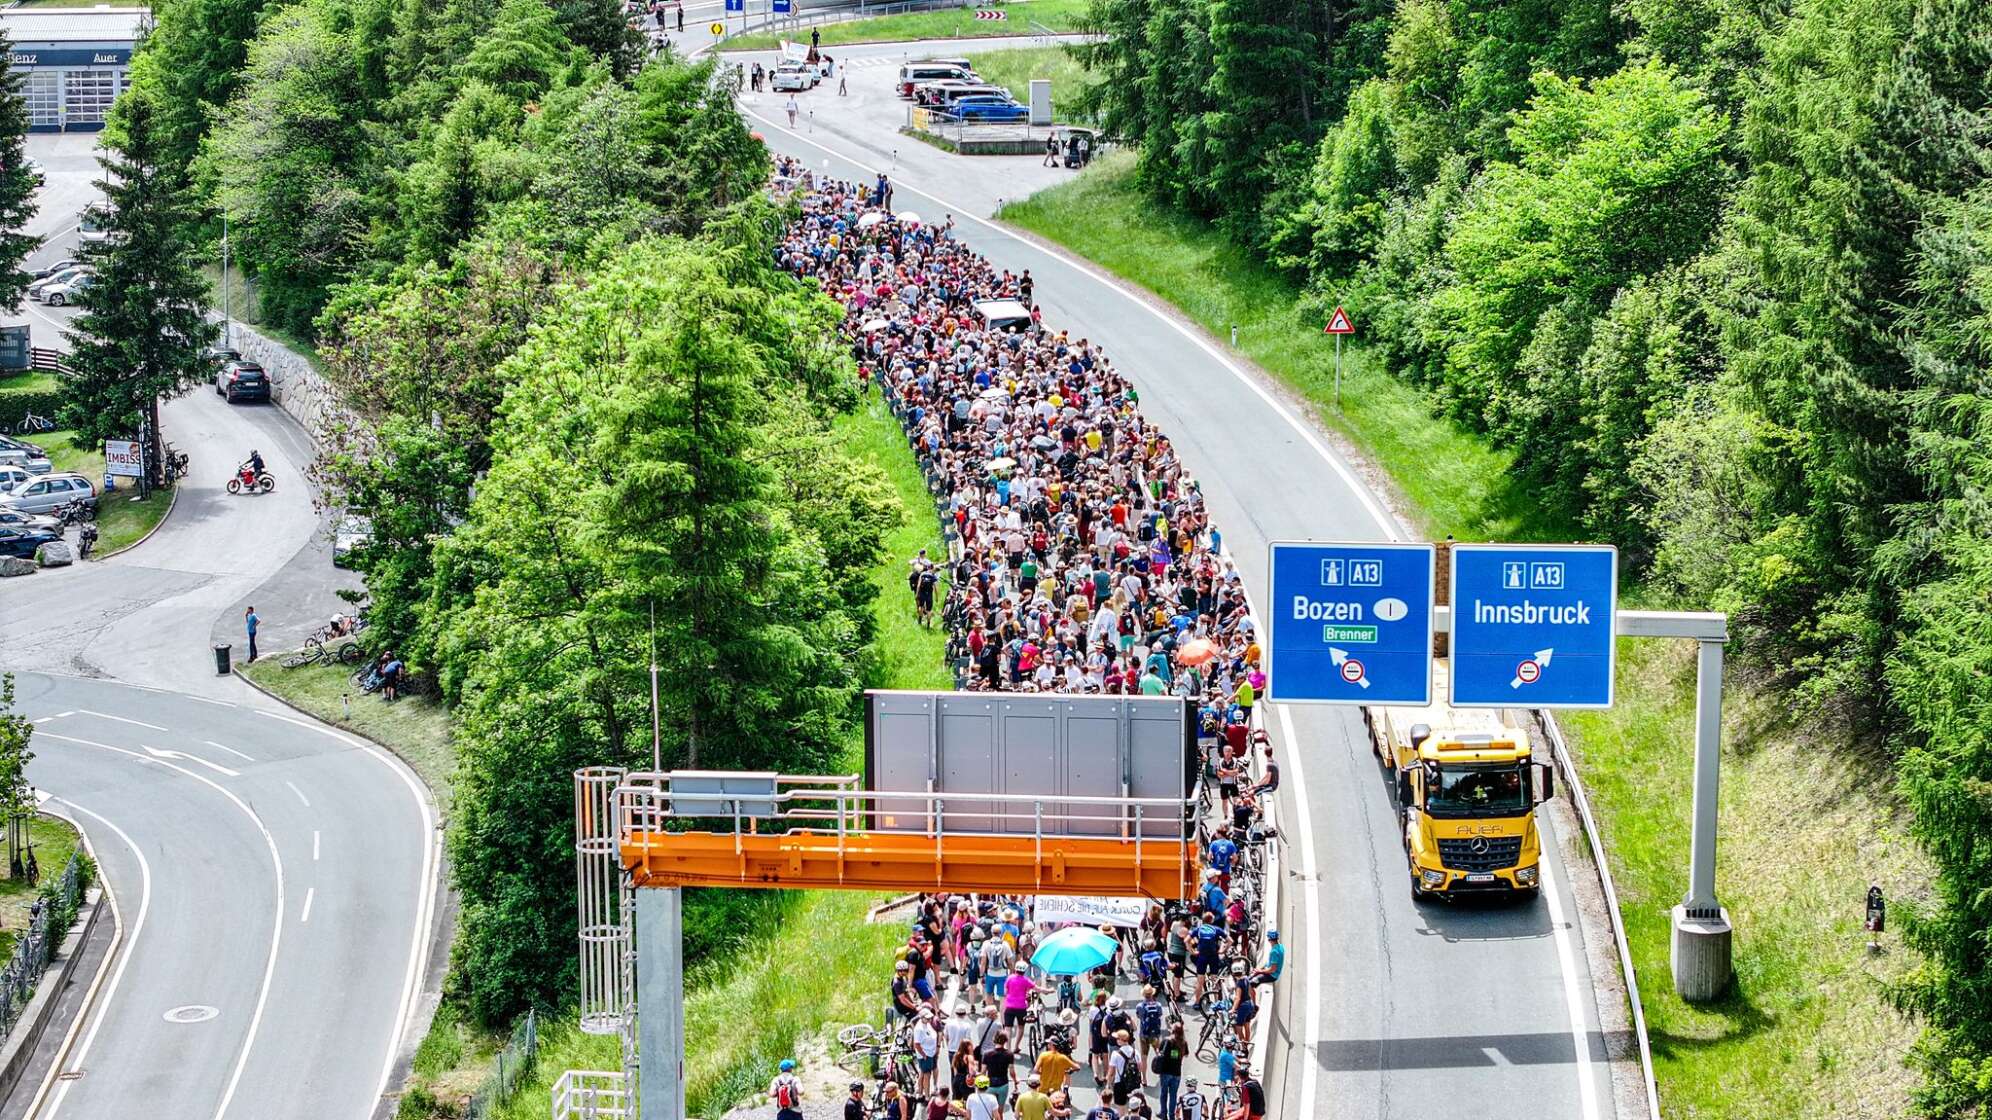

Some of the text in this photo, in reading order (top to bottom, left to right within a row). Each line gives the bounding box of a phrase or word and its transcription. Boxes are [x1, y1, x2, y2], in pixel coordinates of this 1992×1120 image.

[93, 53, 118, 63] Auer
[107, 453, 140, 464] IMBISS
[1352, 564, 1379, 583] A13
[1534, 566, 1561, 585] A13
[1293, 595, 1362, 621] Bozen
[1474, 599, 1591, 625] Innsbruck
[1326, 627, 1374, 641] Brenner
